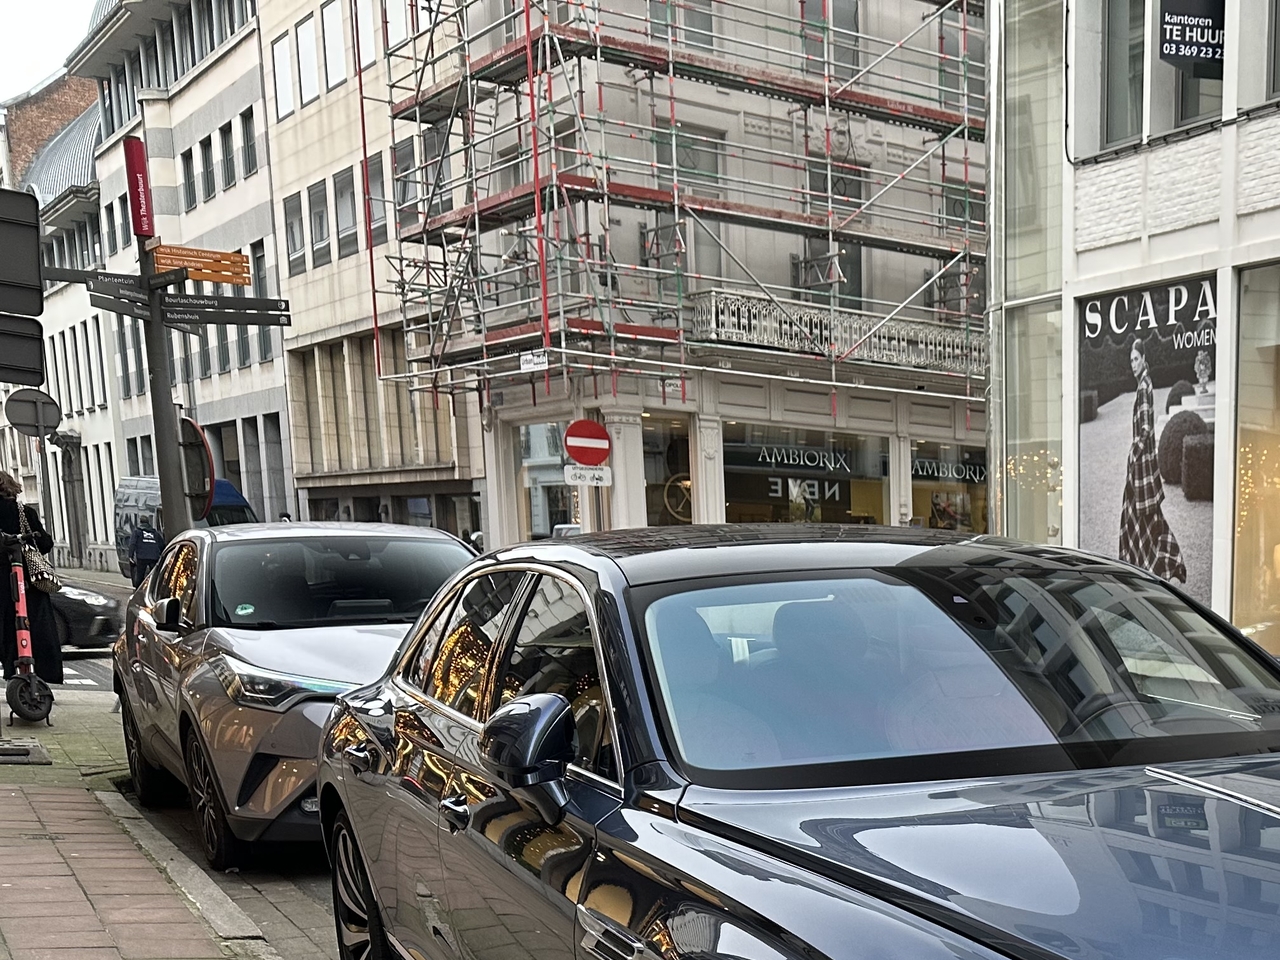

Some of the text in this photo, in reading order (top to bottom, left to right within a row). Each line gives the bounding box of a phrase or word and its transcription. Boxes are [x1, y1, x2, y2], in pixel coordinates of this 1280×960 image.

[1165, 12, 1212, 27] kantoren
[1163, 25, 1182, 41] TE
[1163, 43, 1224, 59] 03 369 23 2
[172, 248, 198, 257] Historisch
[97, 275, 135, 285] Plantentuin
[166, 312, 200, 320] Rubenshuis
[1084, 280, 1217, 338] SCAPA
[1172, 328, 1217, 350] WOMEN
[758, 446, 851, 473] AMBIORIX
